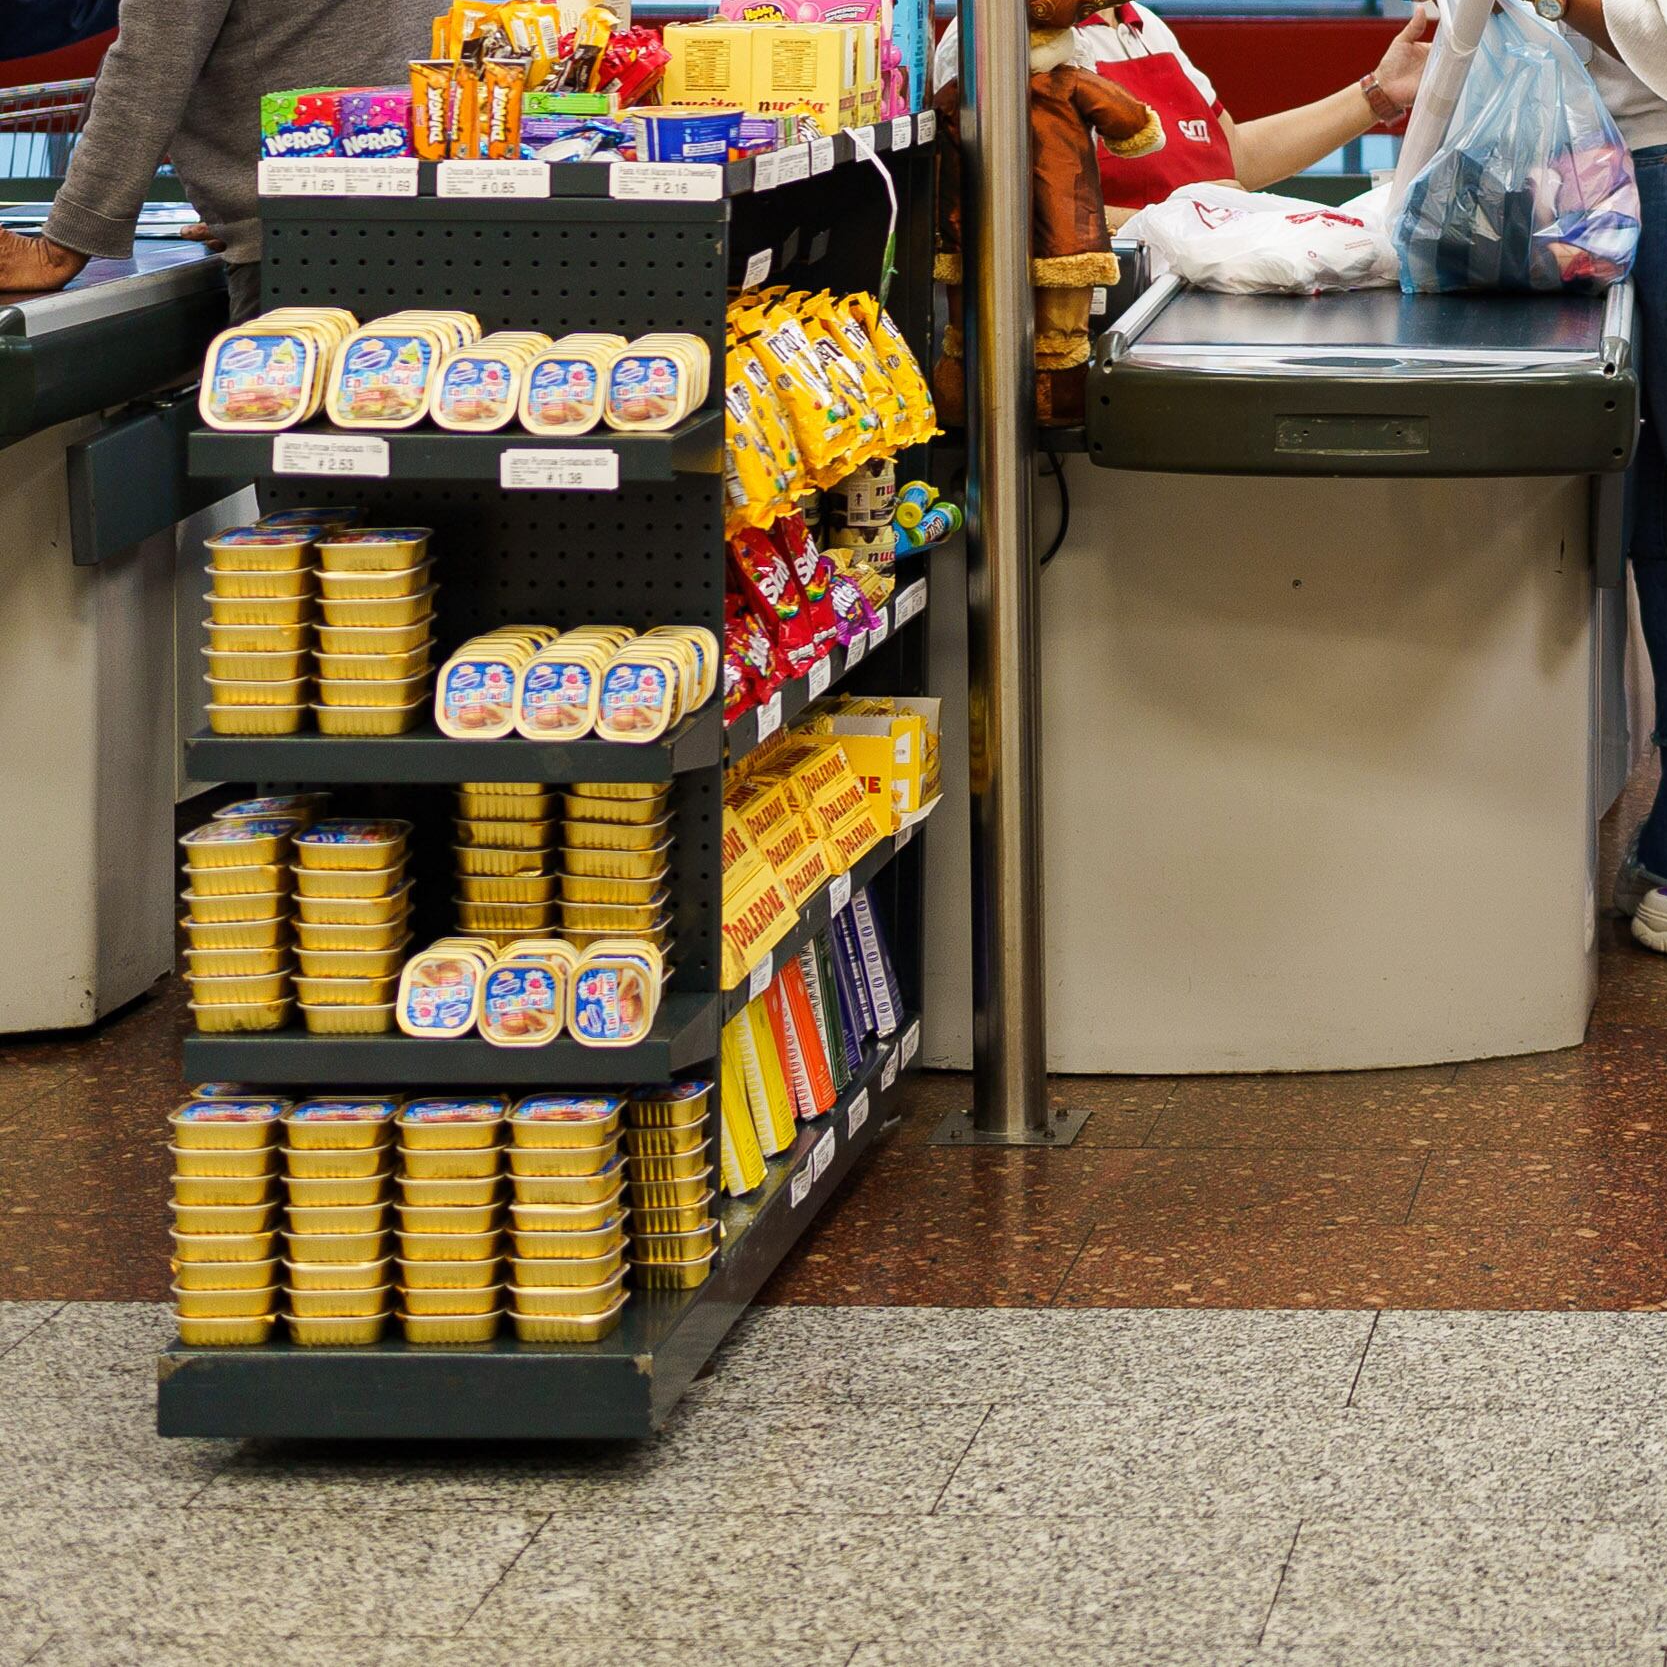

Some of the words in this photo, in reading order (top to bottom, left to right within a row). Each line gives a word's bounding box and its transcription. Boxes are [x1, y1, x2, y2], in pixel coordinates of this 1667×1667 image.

[801, 754, 845, 800] TOBLERONE
[746, 796, 786, 845] TOBLERONE
[818, 783, 864, 830] TOBLERONE
[766, 826, 804, 873] TOBLERONE
[835, 817, 877, 864] TOBLERONE
[785, 852, 825, 904] TOBLERONE
[723, 884, 785, 961] TOBLERONE
